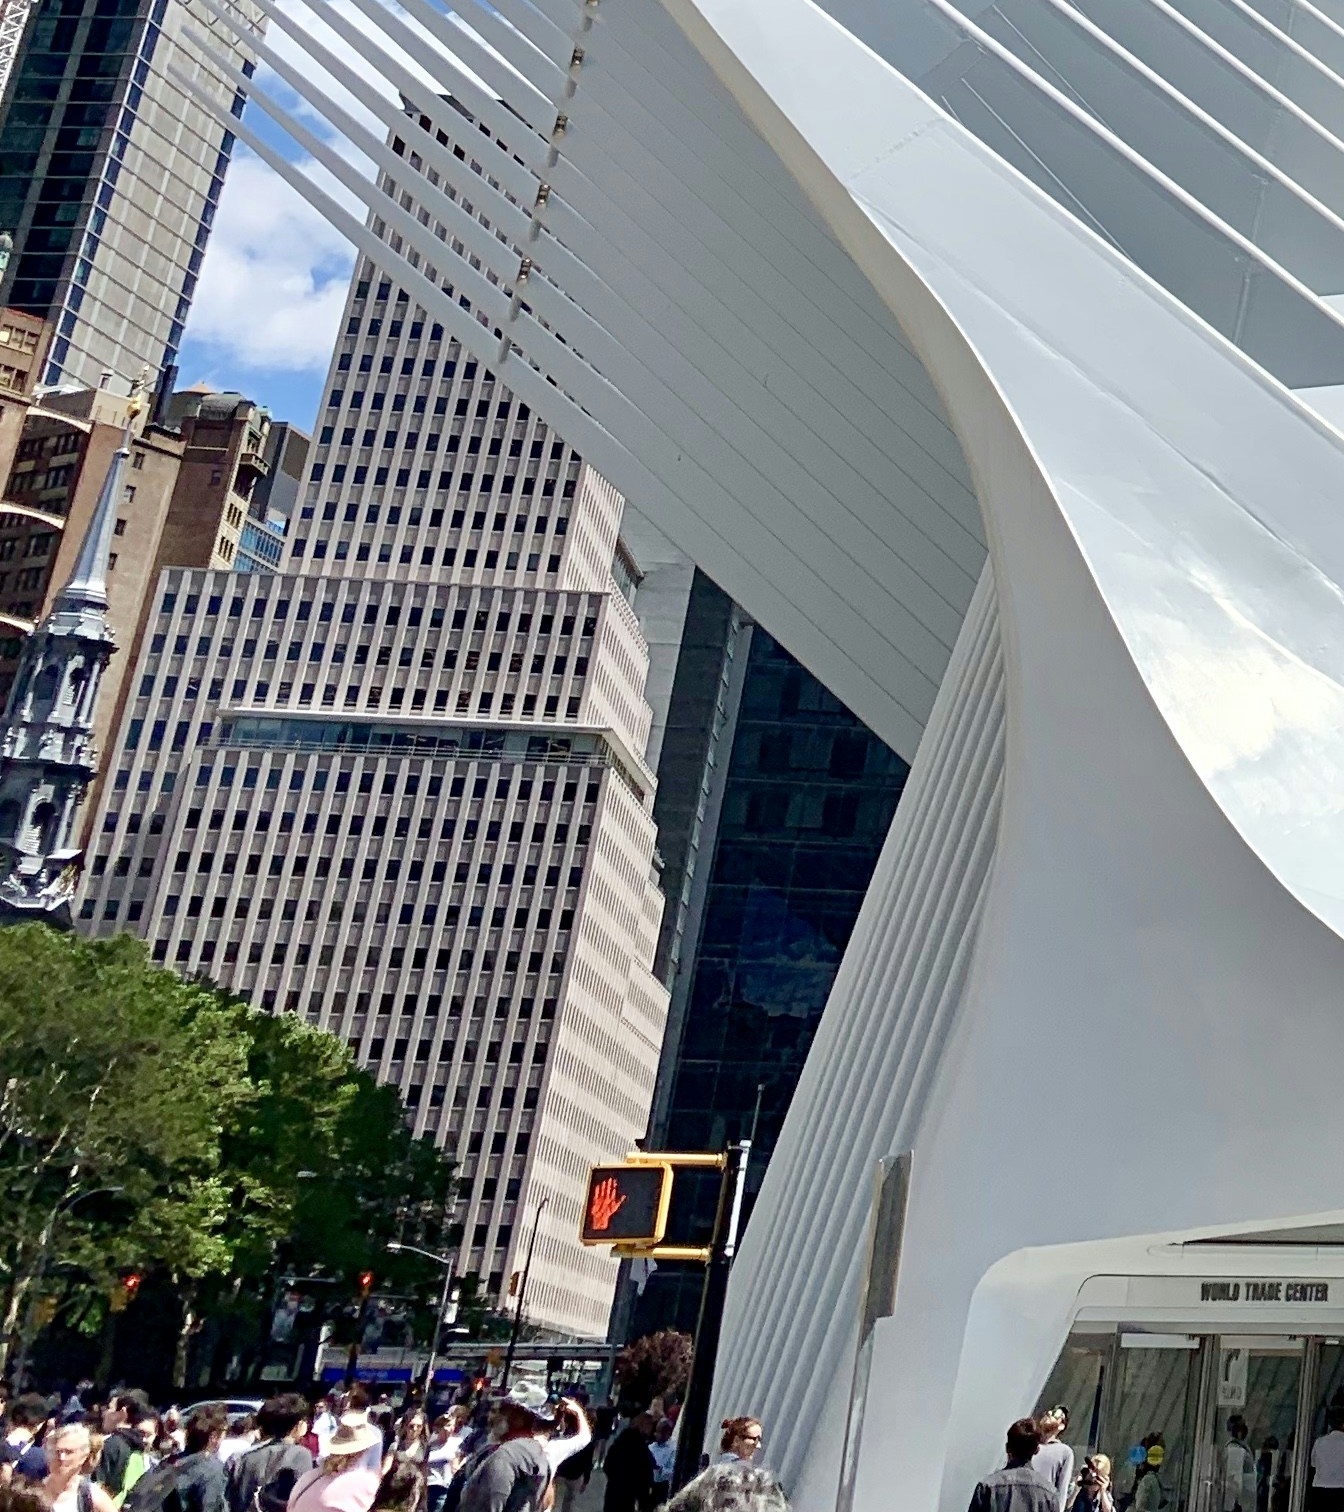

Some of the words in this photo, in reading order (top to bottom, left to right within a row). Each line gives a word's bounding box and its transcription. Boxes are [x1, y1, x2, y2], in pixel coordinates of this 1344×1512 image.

[1201, 1282, 1240, 1301] WORLD
[1245, 1282, 1282, 1301] TRADE
[1286, 1283, 1329, 1302] CENTER
